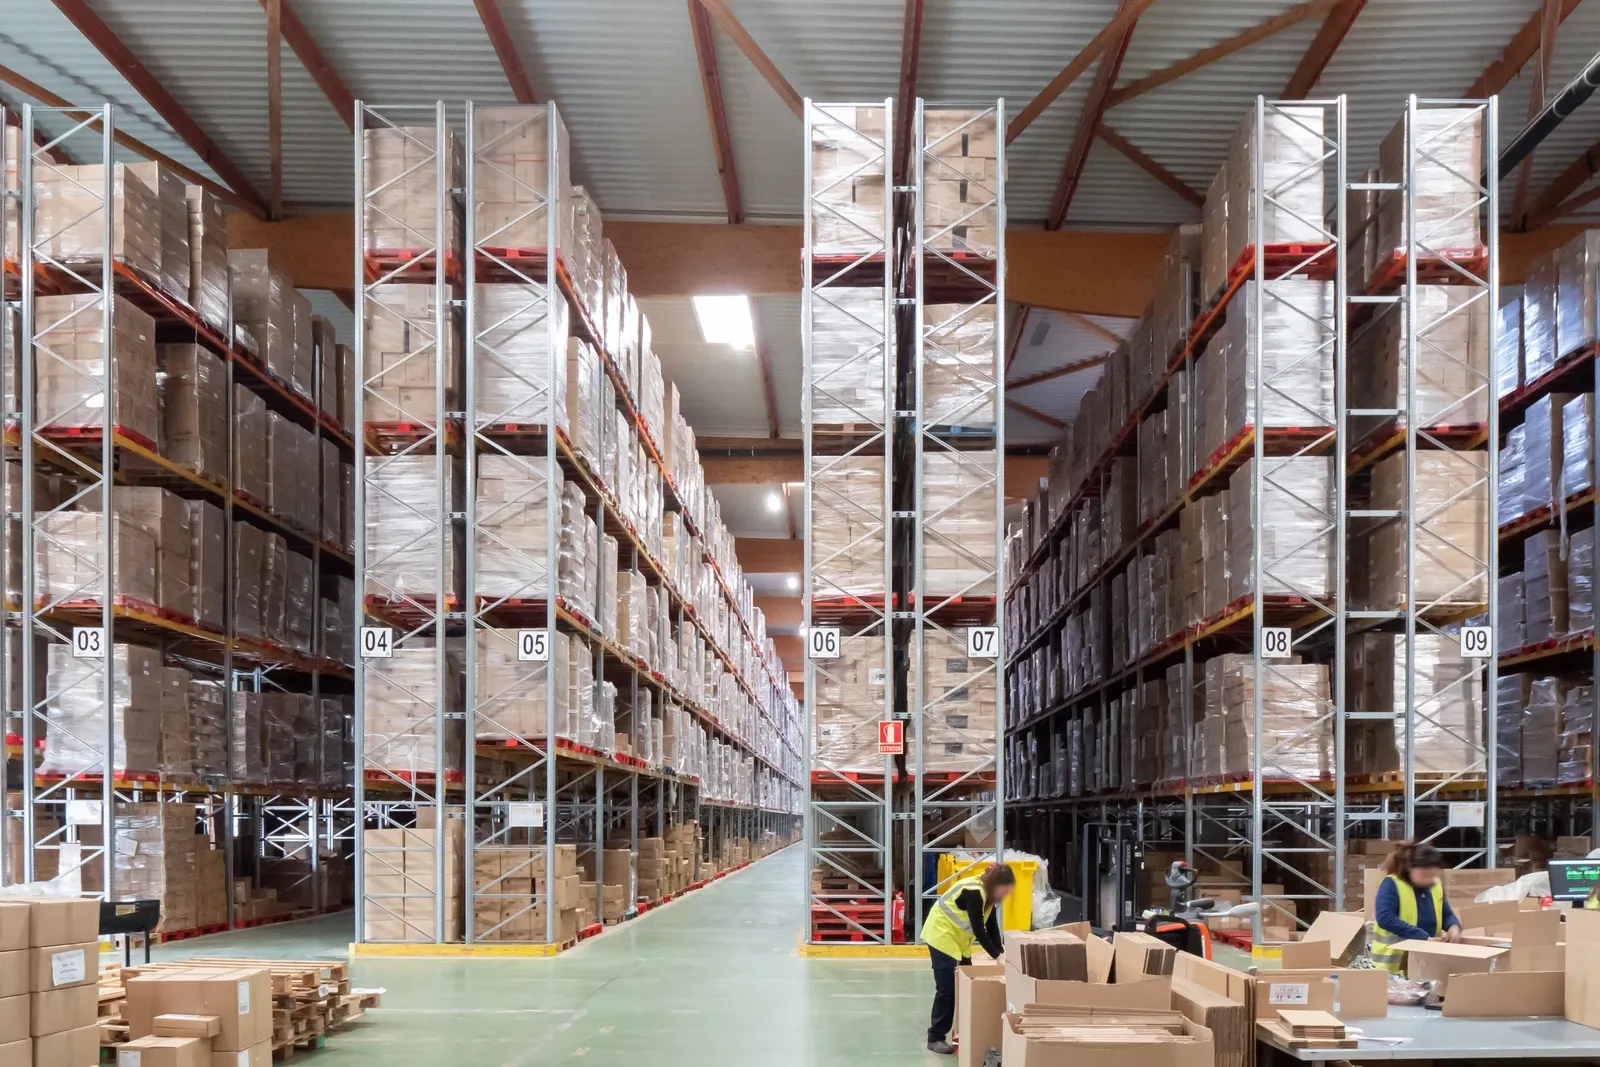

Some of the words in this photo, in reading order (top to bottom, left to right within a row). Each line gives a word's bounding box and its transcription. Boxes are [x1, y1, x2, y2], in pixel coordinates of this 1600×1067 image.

[77, 631, 99, 652] 03
[365, 631, 388, 652] 04
[523, 634, 545, 655] 05
[813, 631, 836, 653] 06
[972, 631, 995, 652] 07
[1265, 631, 1287, 653] 08
[1465, 630, 1488, 651] 09
